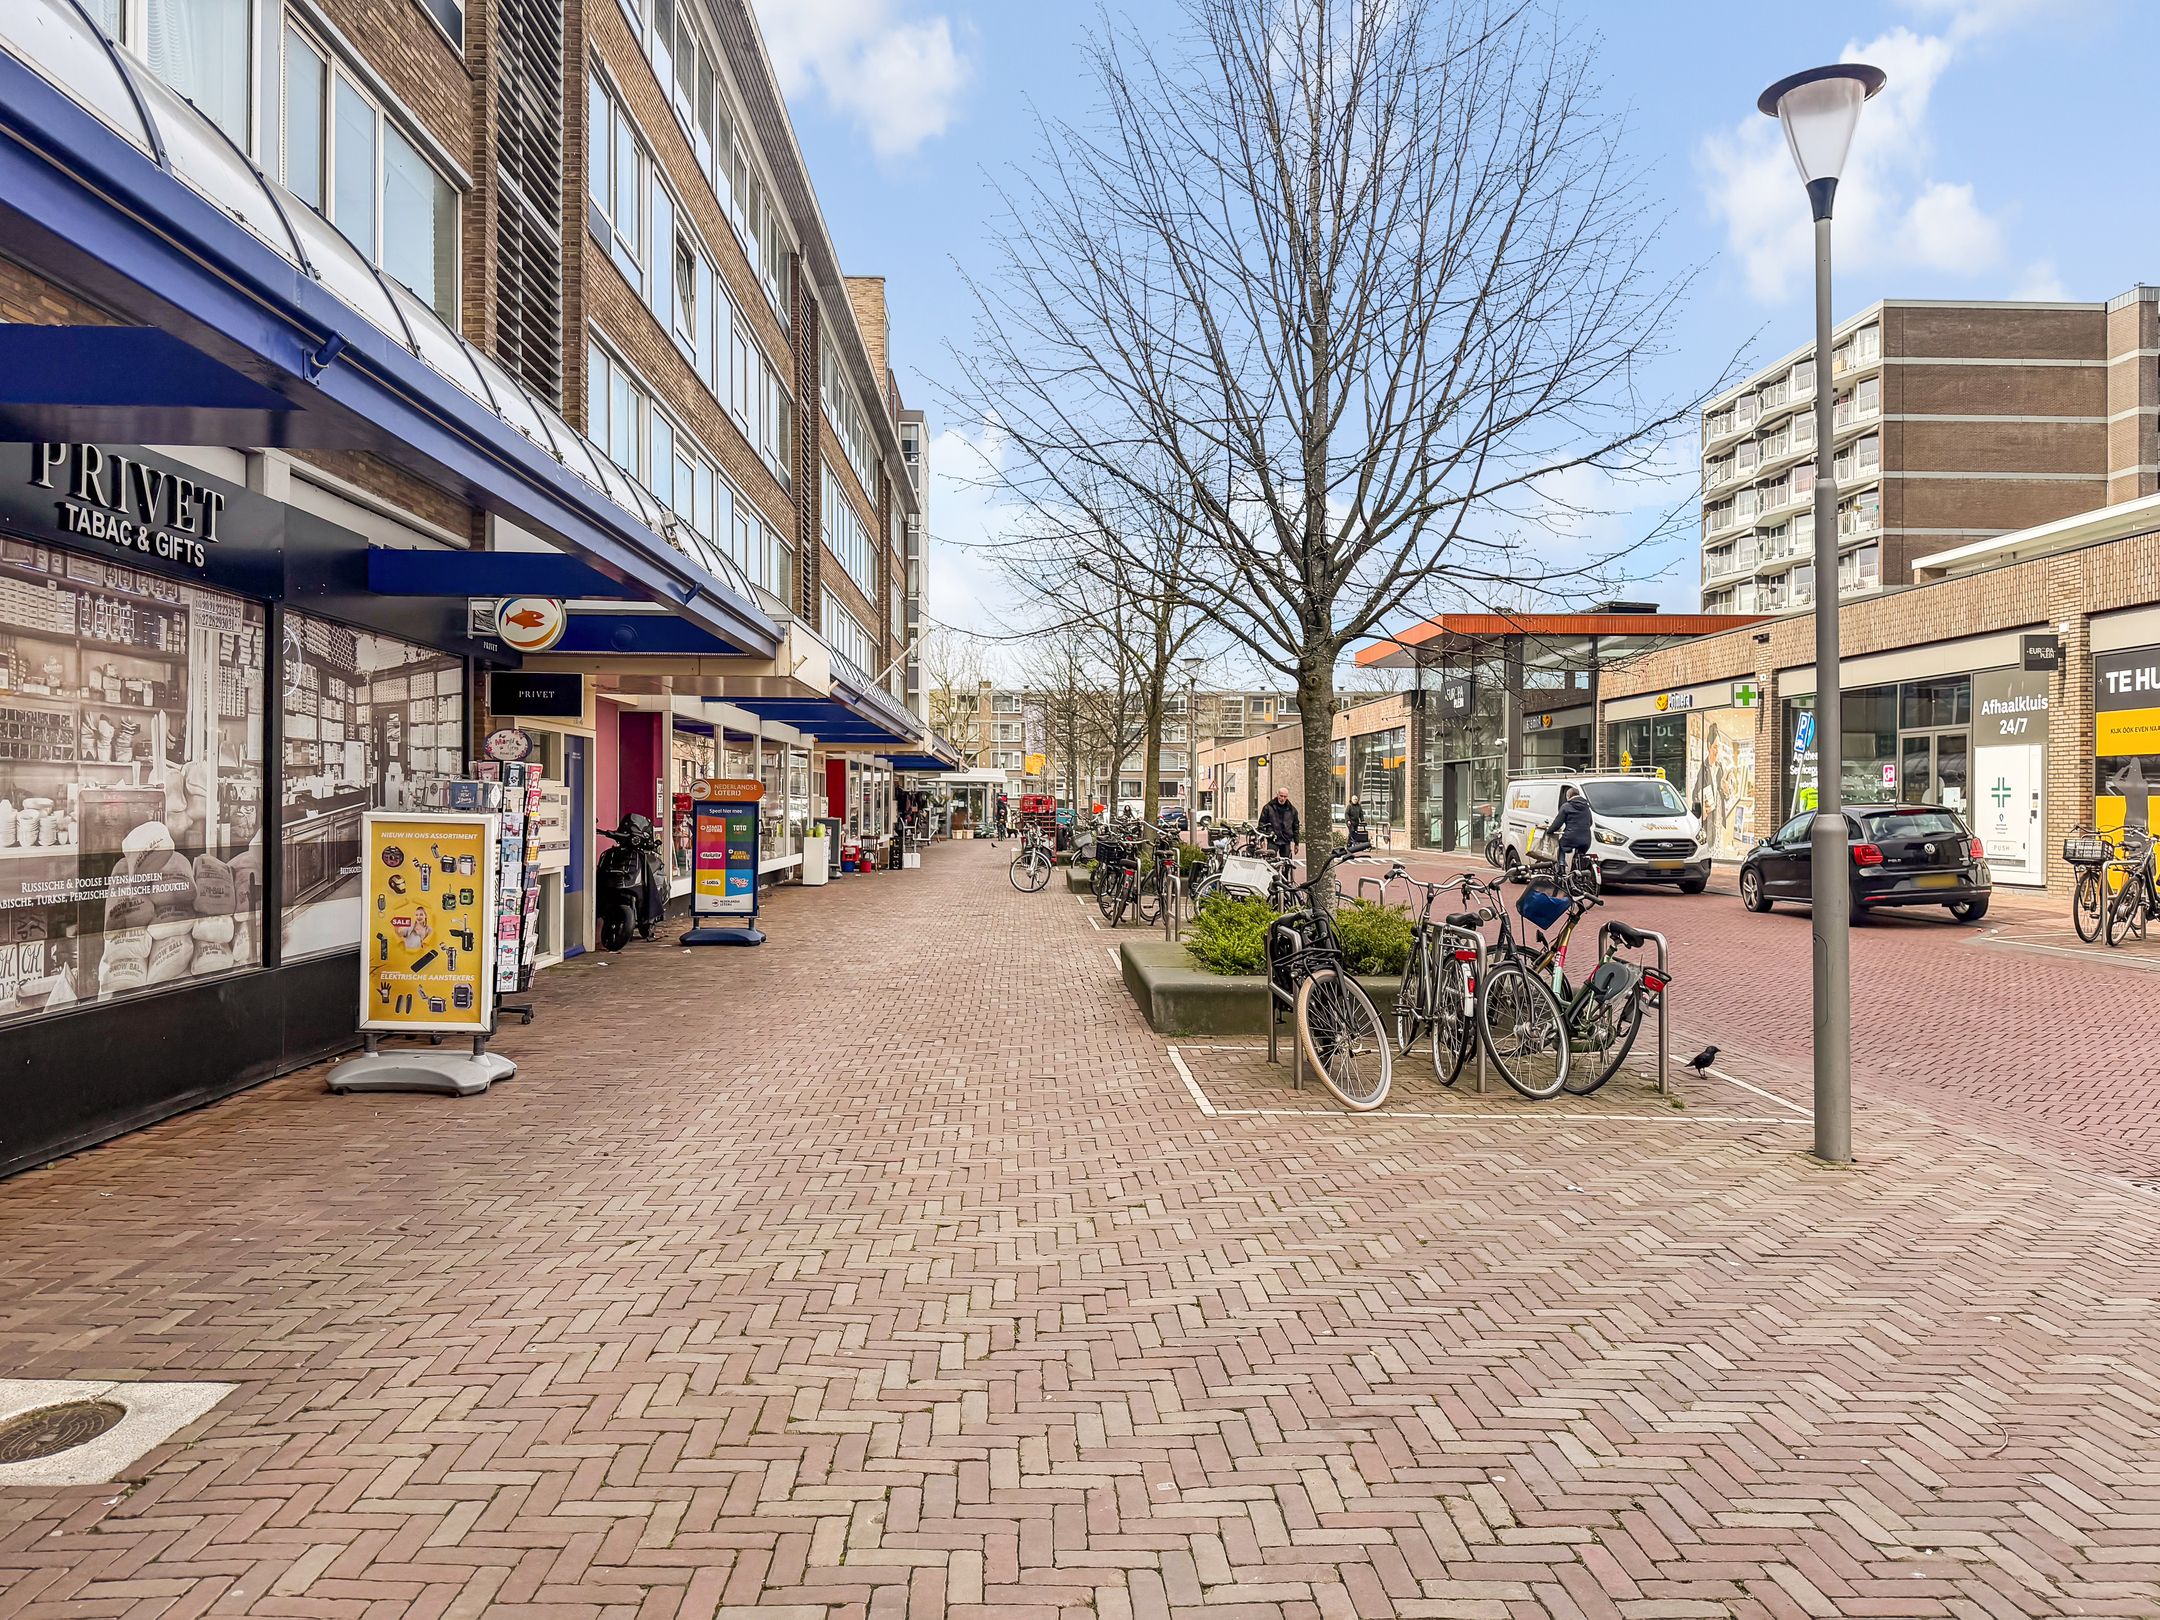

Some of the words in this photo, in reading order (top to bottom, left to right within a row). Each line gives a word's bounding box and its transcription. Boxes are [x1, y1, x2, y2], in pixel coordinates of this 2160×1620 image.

[38, 443, 225, 543] PRIVET
[65, 502, 132, 546] TABAC
[137, 525, 150, 553] &
[155, 531, 206, 568] GIFTS
[2105, 669, 2132, 694] TE
[518, 690, 555, 699] PRIVET
[1981, 693, 2049, 716] Afhaalkluis
[1642, 725, 1675, 737] LDL
[1999, 717, 2028, 735] 24/7
[2134, 725, 2149, 733] EVEN
[430, 832, 478, 840] ASSORTIMENT
[21, 880, 65, 894] RUSSISCHE
[66, 880, 74, 889] &
[75, 877, 103, 888] POOLSE
[104, 873, 163, 886] LEVENSMIDDELEN
[36, 893, 68, 905] TURKSE,
[70, 890, 109, 902] PERZISCHE
[110, 888, 118, 898] &
[118, 885, 151, 896] INDISCHE
[152, 882, 190, 893] PRODUKTEN
